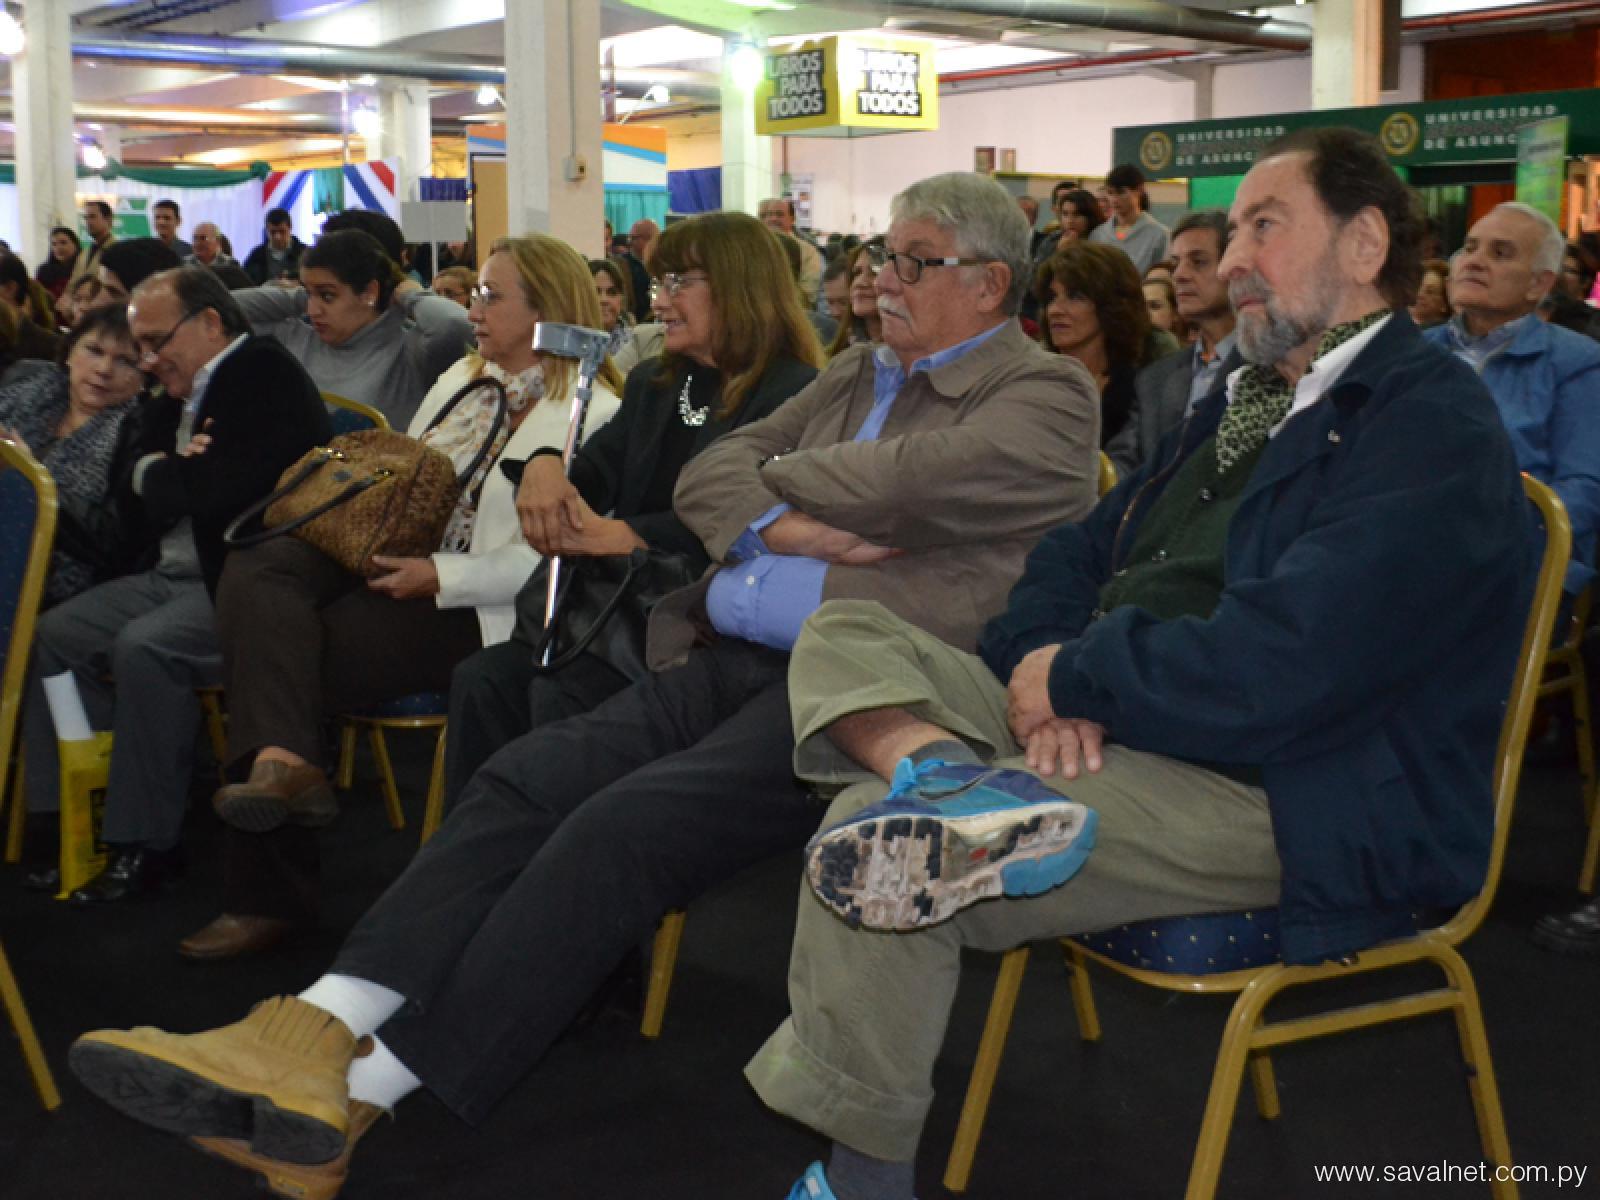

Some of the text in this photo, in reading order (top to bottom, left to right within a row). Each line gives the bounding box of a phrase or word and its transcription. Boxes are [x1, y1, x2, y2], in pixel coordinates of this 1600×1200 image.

[781, 73, 820, 96] PARA
[871, 71, 915, 92] PARA
[768, 93, 823, 118] TODOS
[860, 92, 918, 114] TODOS
[1425, 104, 1557, 125] UNIVERSIDAD
[1175, 125, 1285, 143] UNIVERSIDAD
[1423, 139, 1447, 149] DE
[1455, 133, 1518, 147] ASUNC
[1175, 151, 1253, 166] DE ASUNC
